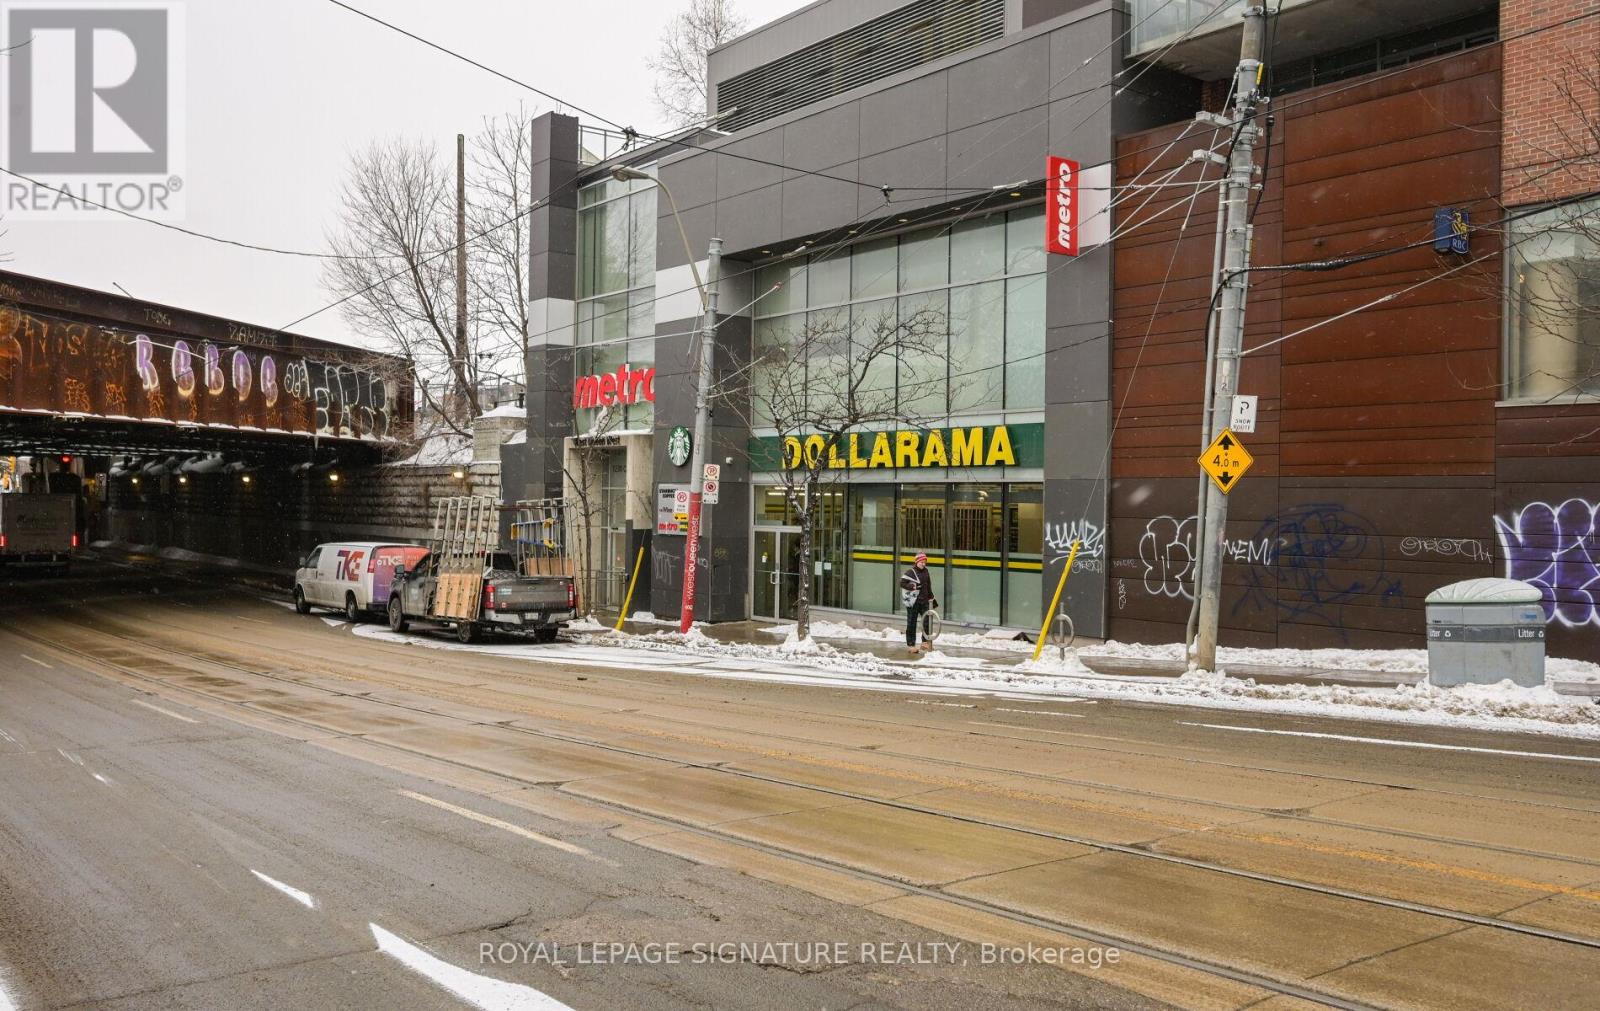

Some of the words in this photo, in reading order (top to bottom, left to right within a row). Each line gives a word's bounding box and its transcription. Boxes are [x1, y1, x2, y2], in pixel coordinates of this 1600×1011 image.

[1056, 162, 1072, 249] metro
[782, 425, 1016, 470] DOLLARAMA
[1213, 454, 1229, 467] 4.0
[1517, 628, 1535, 638] Litter
